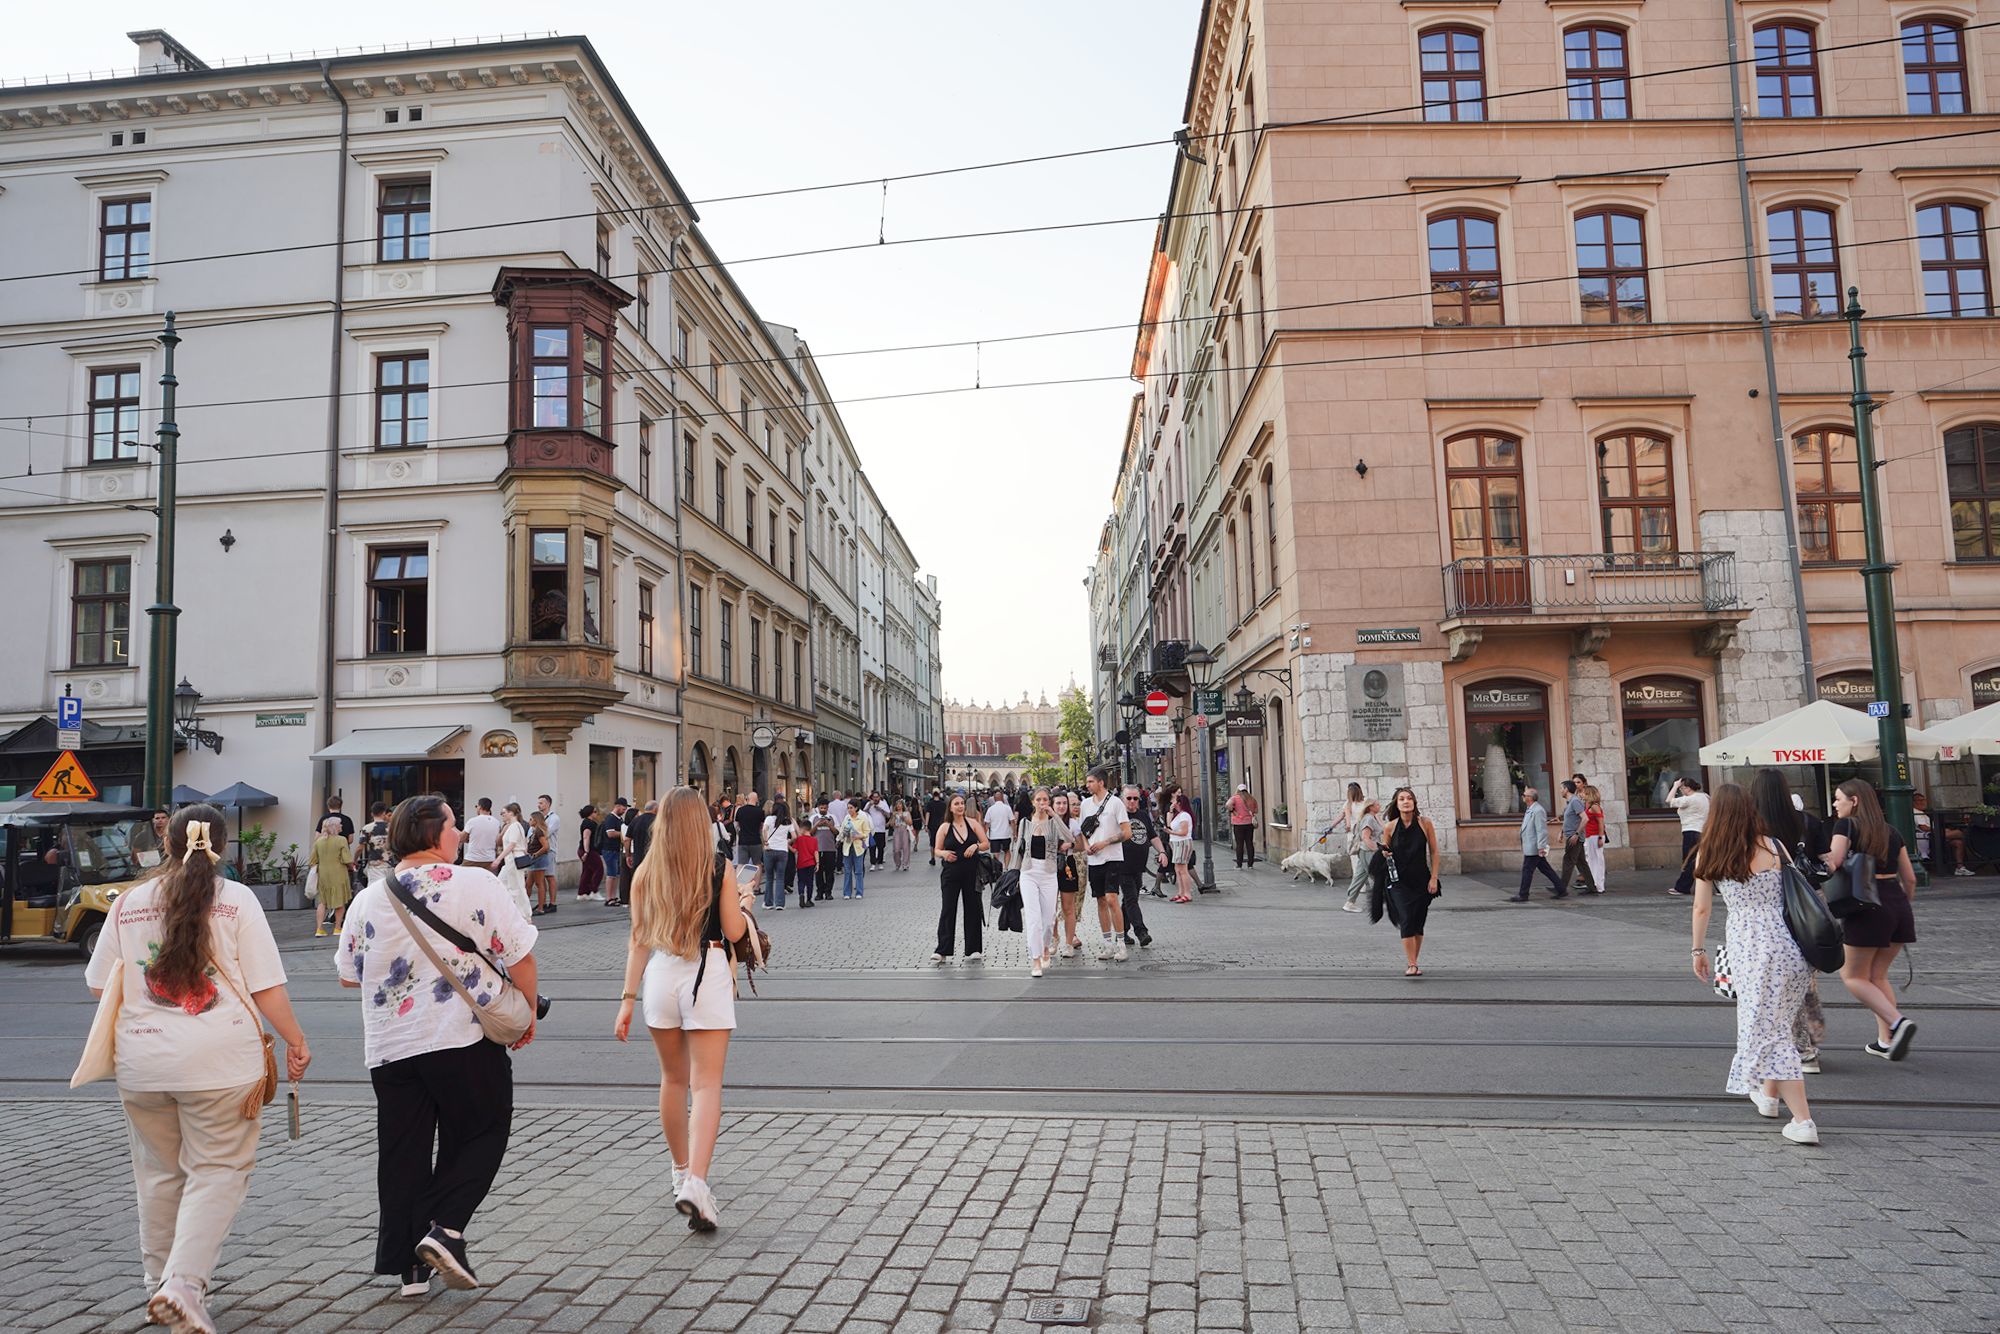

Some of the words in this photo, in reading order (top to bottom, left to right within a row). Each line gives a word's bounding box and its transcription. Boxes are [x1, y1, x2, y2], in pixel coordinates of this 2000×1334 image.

[1502, 693, 1530, 701] BEEF
[1655, 690, 1683, 698] BEEF
[64, 700, 78, 720] P
[1869, 704, 1888, 716] TAXI
[1772, 749, 1826, 762] TYSKIE
[120, 914, 160, 925] MARKET
